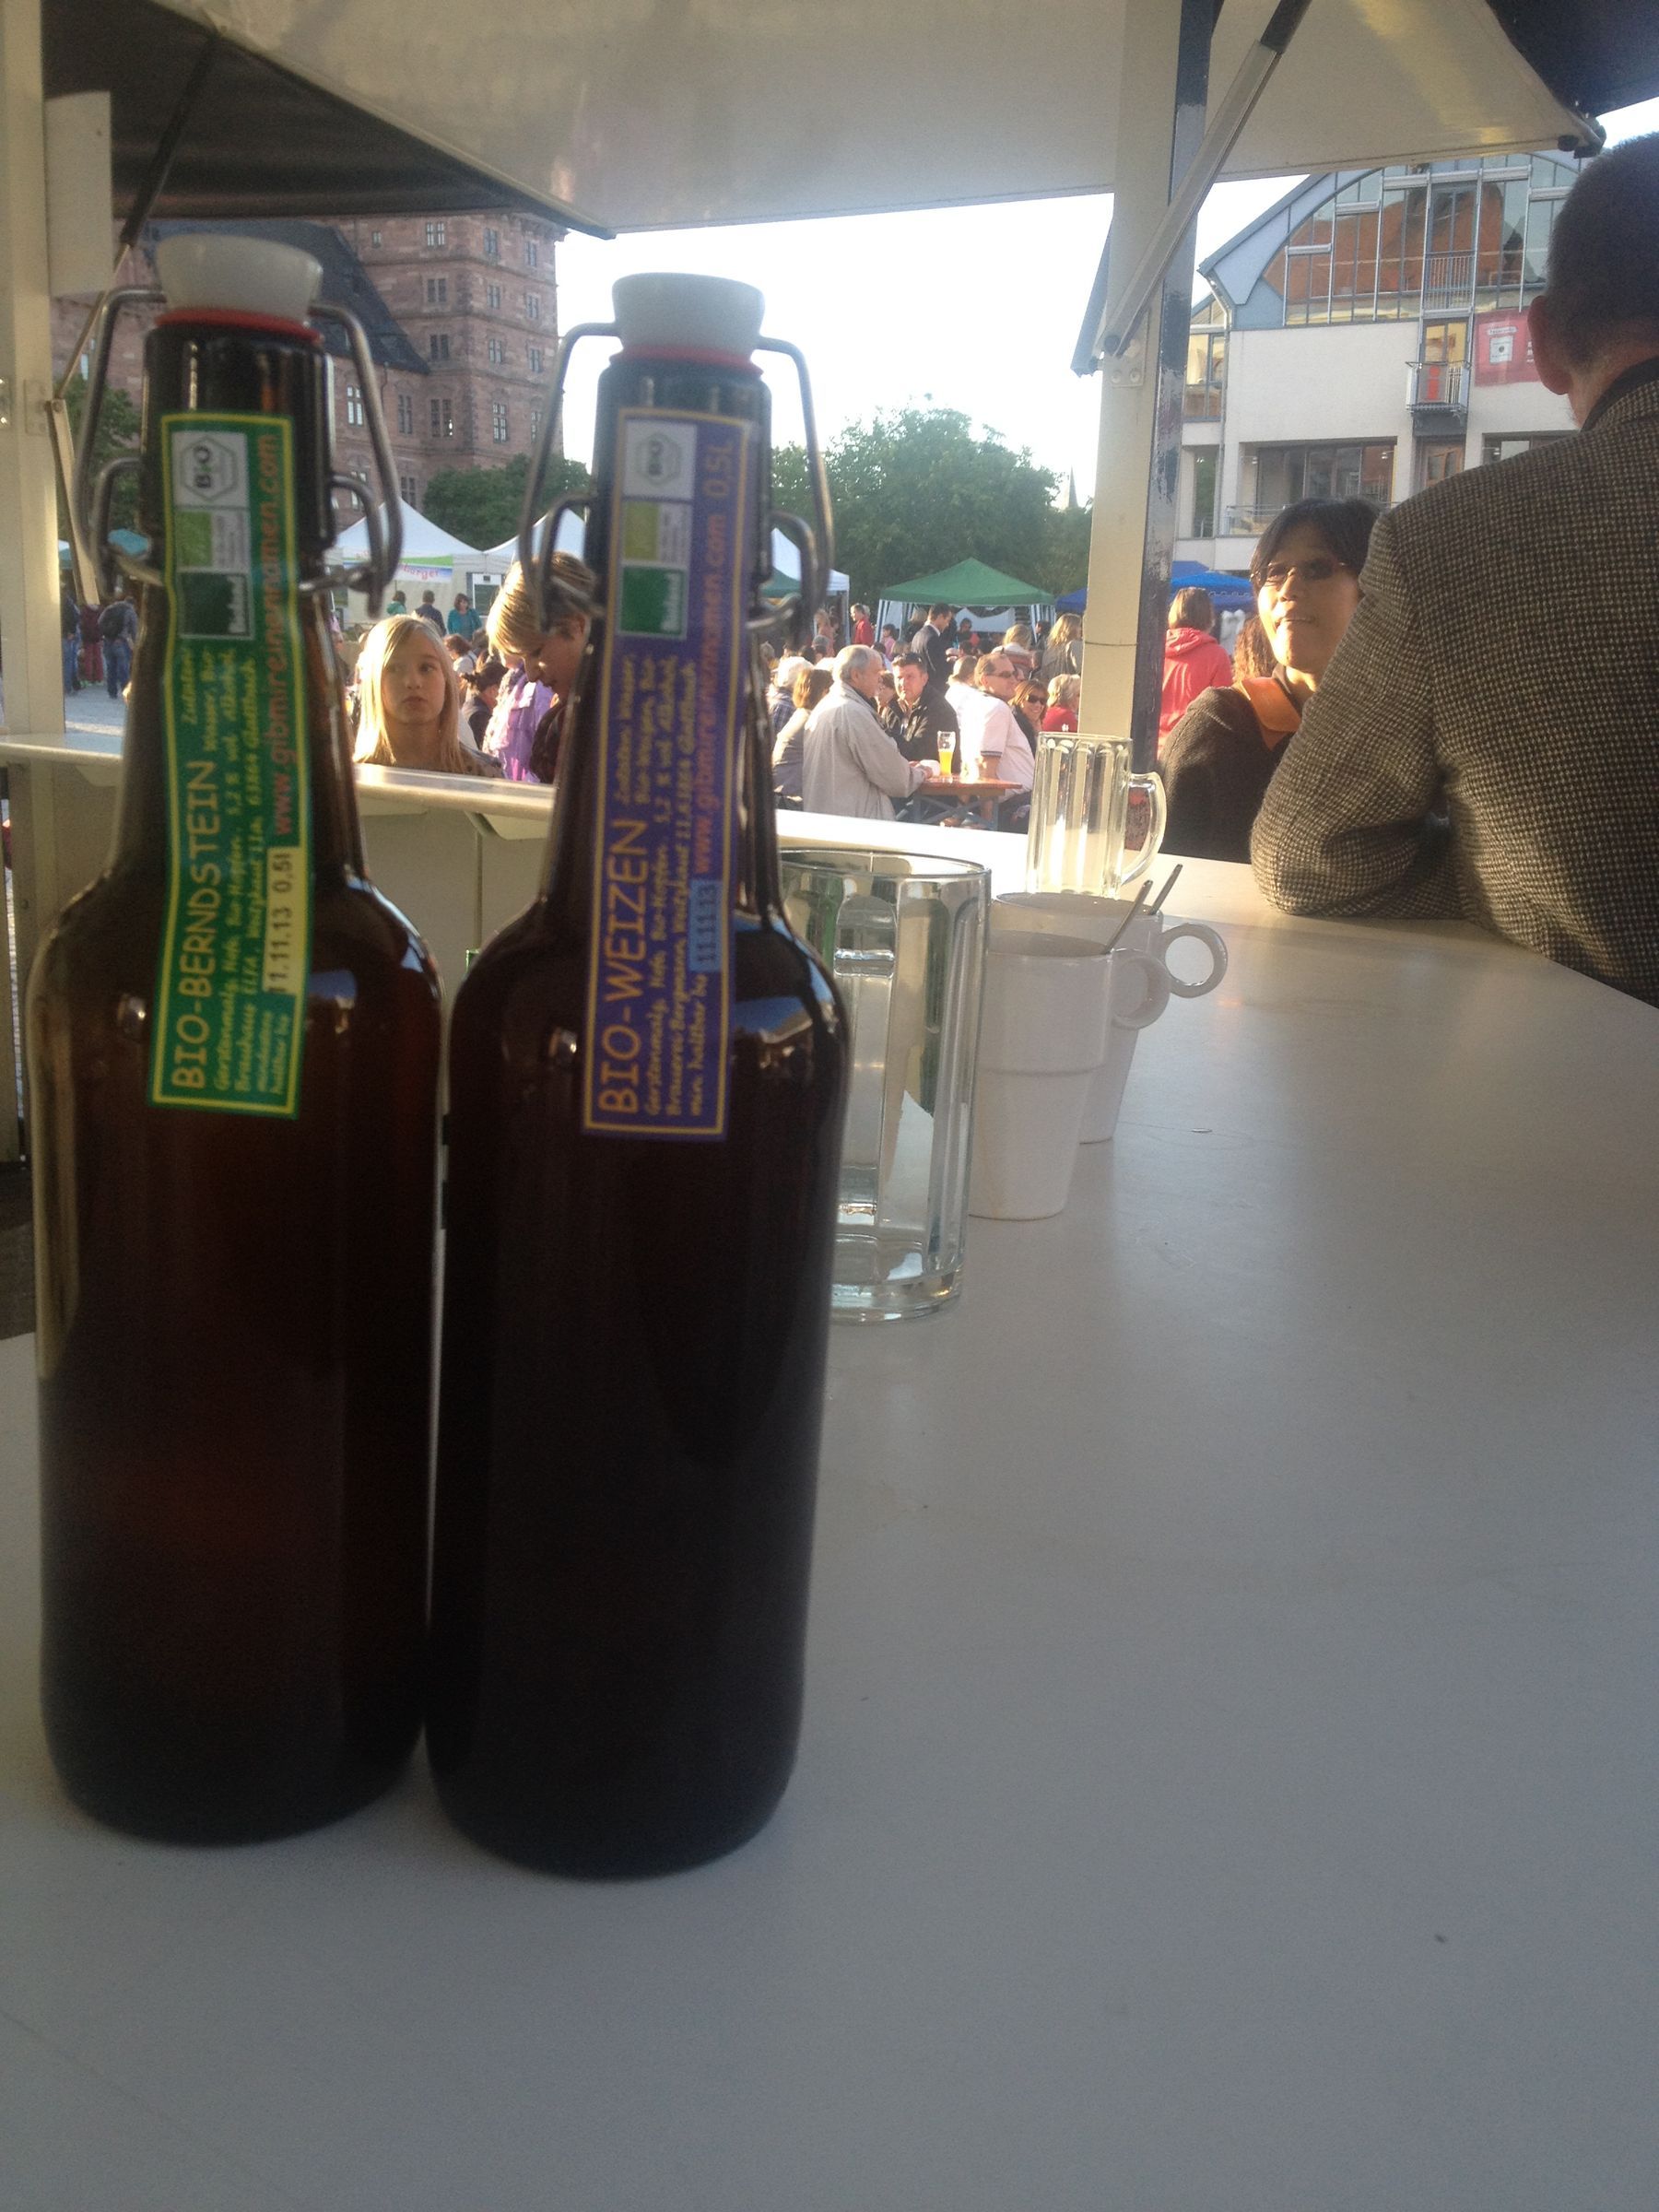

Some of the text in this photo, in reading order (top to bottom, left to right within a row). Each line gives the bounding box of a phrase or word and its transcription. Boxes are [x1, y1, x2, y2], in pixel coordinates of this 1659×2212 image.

[172, 761, 221, 1088] BIO-BERNDSTEIN
[235, 1004, 256, 1091] Brauhaus
[597, 820, 649, 1113] BIO-WEIZEN
